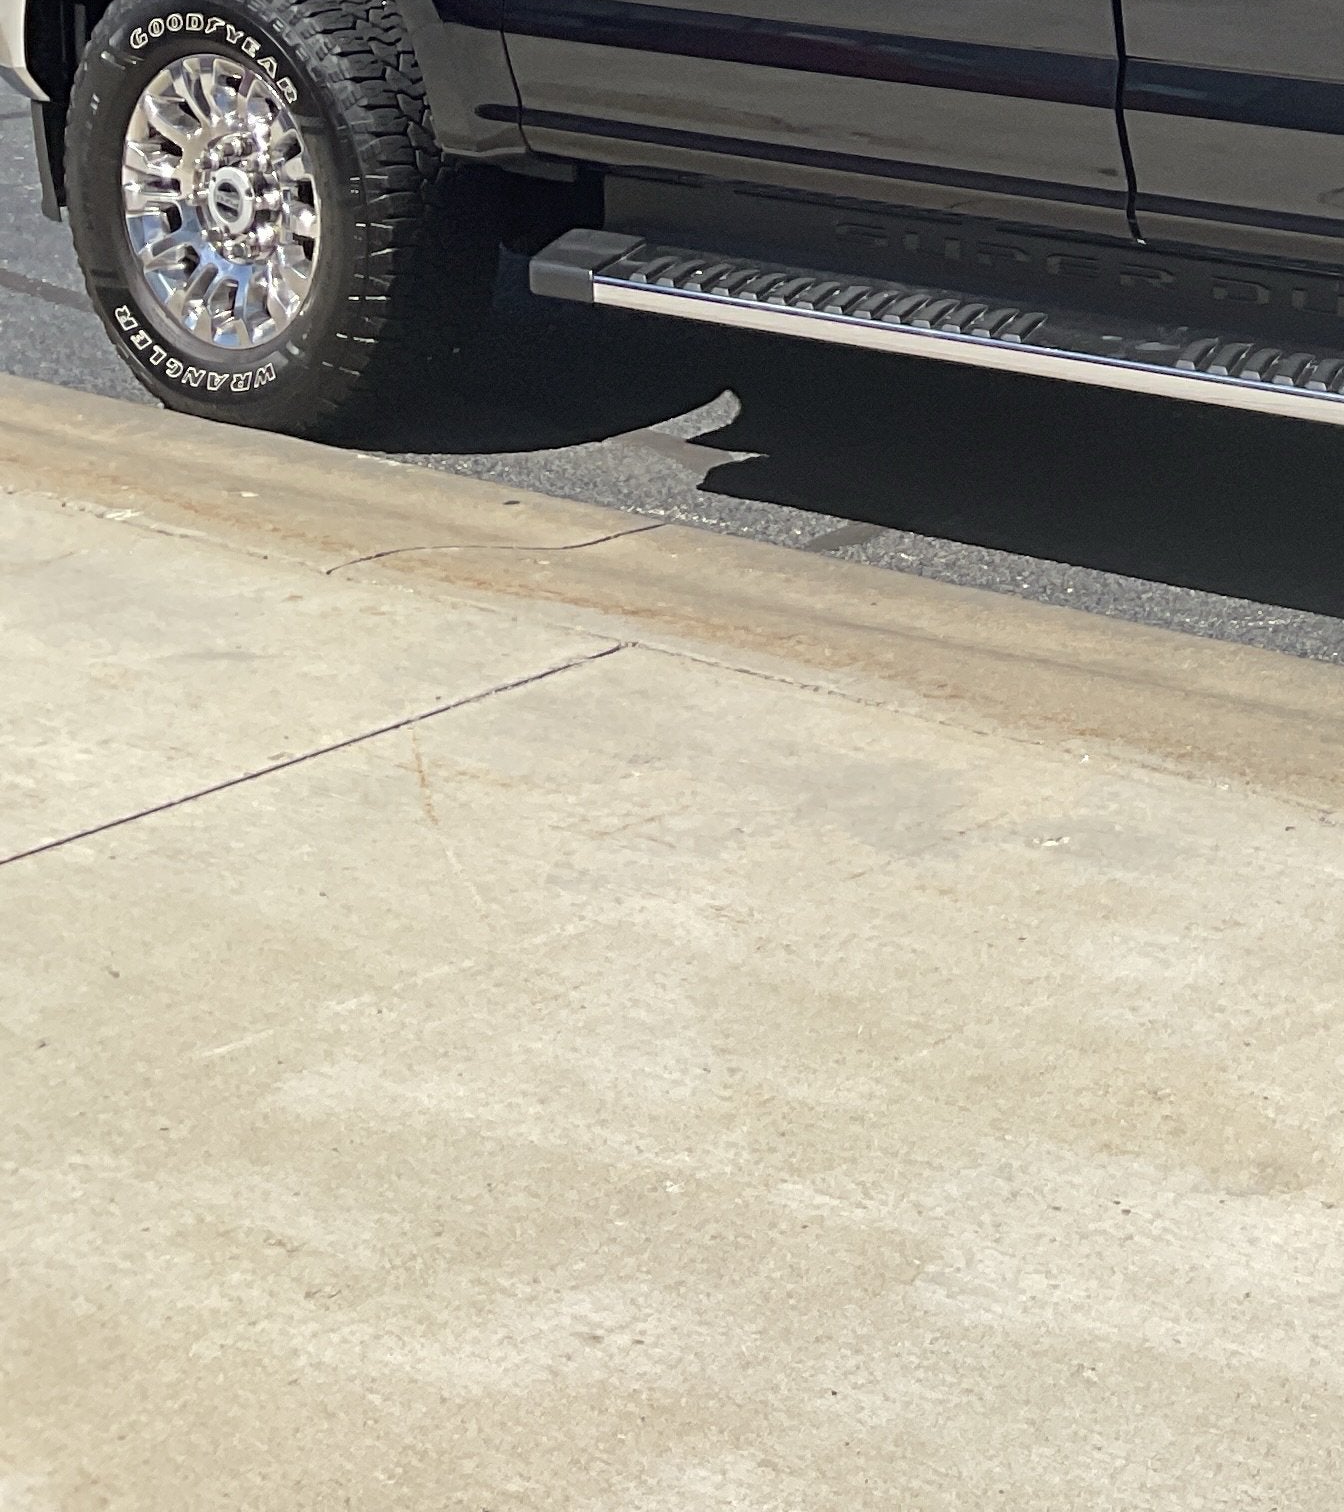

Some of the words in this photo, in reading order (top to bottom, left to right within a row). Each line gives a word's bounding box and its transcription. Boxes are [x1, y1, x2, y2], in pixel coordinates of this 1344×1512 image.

[130, 13, 297, 104] GOODYEAR
[835, 221, 1175, 288] SUPER
[115, 305, 276, 392] WRANGLER
